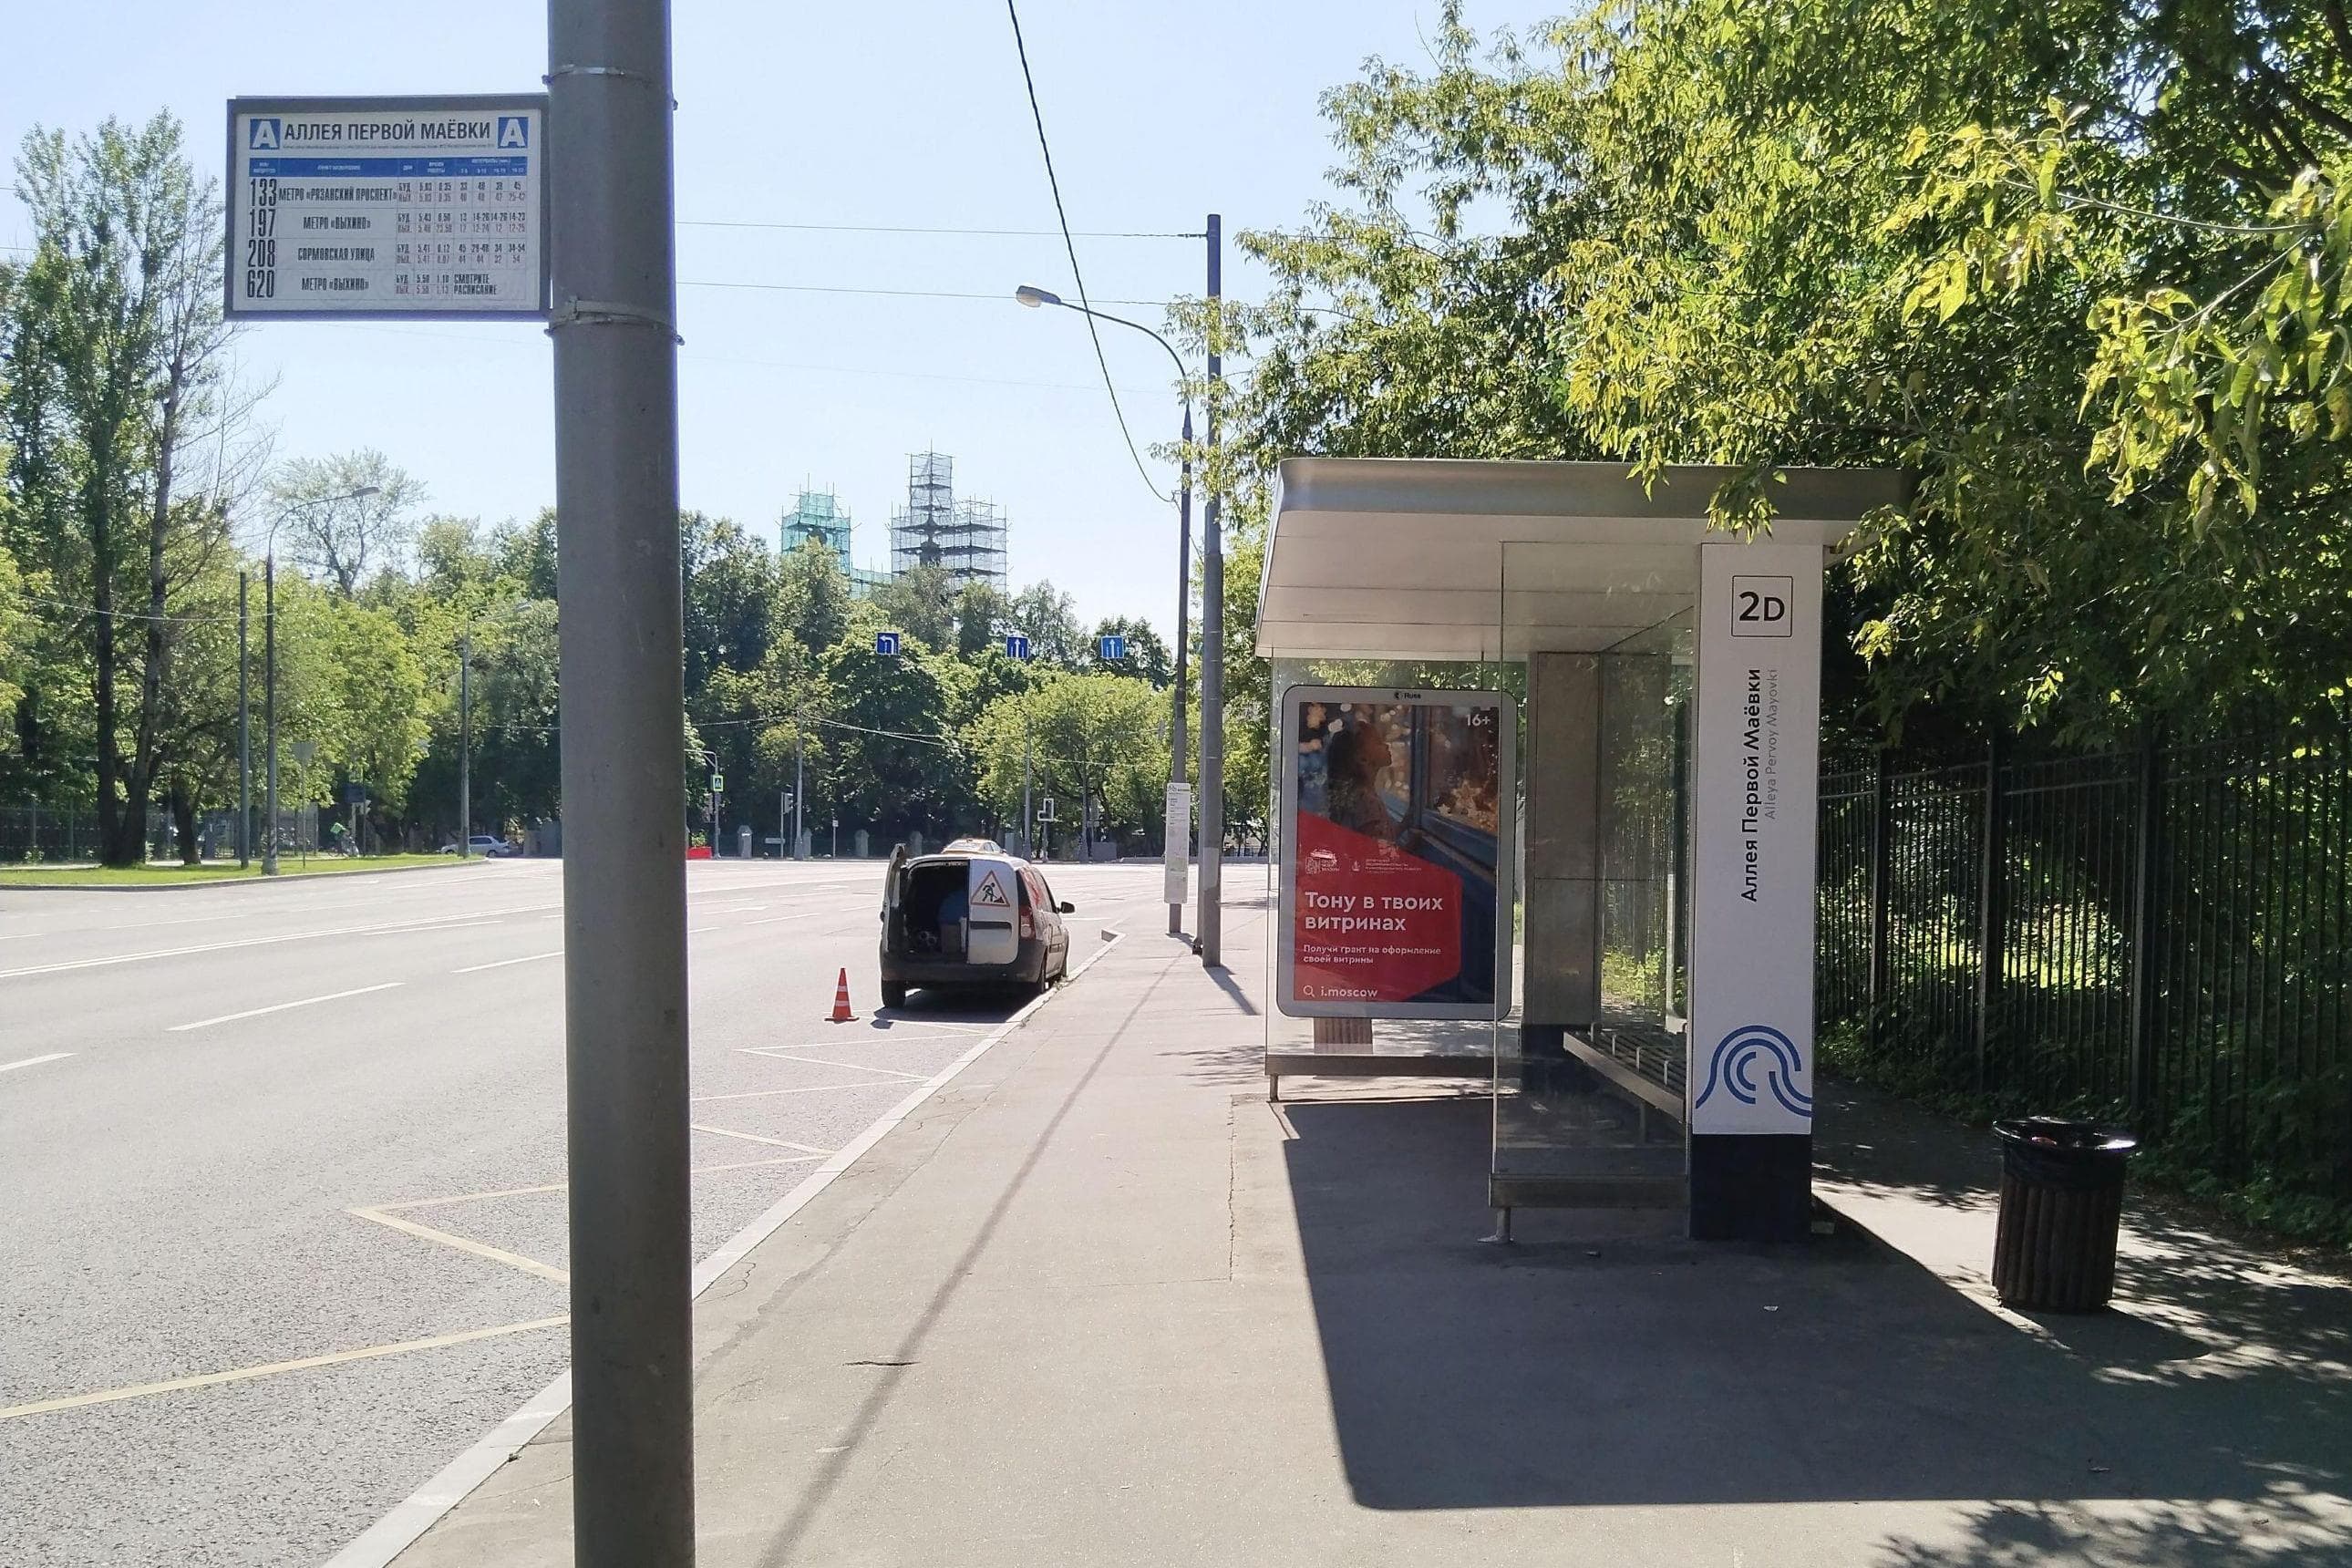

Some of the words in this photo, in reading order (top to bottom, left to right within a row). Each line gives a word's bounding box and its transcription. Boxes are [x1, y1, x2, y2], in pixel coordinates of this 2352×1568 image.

[284, 123, 342, 140] АЛЛЕЯ
[348, 119, 415, 139] ПЕРВОЙ
[420, 119, 490, 139] МАЁВКИ
[250, 178, 277, 207] 133
[278, 188, 304, 201] МЕТРО
[249, 209, 277, 237] 197
[303, 216, 329, 230] МЕТРО
[247, 239, 276, 268] 208
[297, 247, 348, 261] СОРМОВСКАЯ
[350, 247, 376, 263] УЛИЦА
[246, 269, 275, 298] 620
[301, 277, 327, 291] МЕТРО
[1738, 591, 1786, 622] 2D
[1742, 668, 1761, 751] Маёвки
[1765, 669, 1779, 727] Mayovki
[1466, 714, 1491, 727] 16+
[1765, 727, 1779, 775] Pervoy
[1741, 755, 1762, 833] Первой
[1765, 779, 1779, 820] Alleya
[1740, 839, 1758, 903] Аллея
[1305, 892, 1357, 913] Тону
[1363, 896, 1375, 909] в
[1381, 896, 1444, 911] твоих
[1305, 916, 1407, 934] витринах
[1303, 944, 1338, 955] Получи
[1340, 946, 1367, 955] грант
[1382, 945, 1442, 955] оформление
[1303, 954, 1331, 964] своей
[1333, 956, 1374, 965] витрины
[1320, 985, 1378, 997] i.moscow
